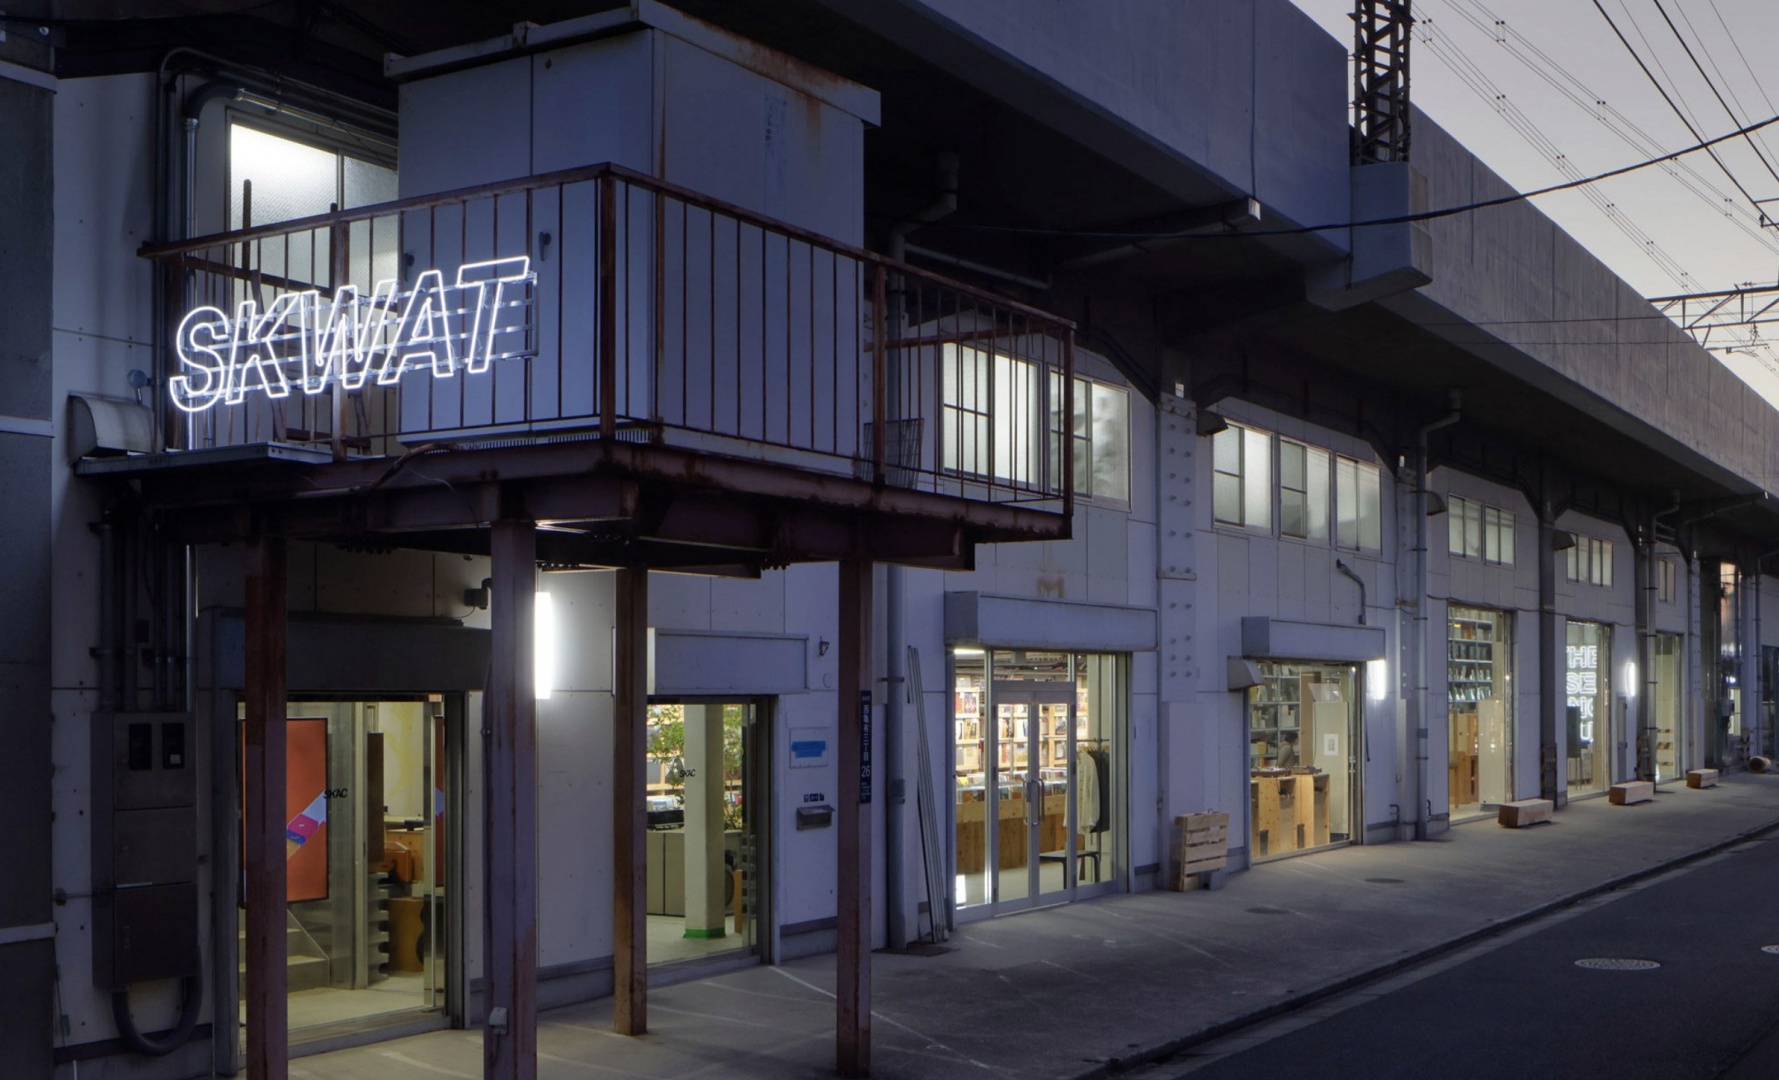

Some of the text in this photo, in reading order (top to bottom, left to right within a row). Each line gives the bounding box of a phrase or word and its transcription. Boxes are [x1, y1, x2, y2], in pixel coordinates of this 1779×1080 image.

[169, 255, 530, 412] SKWAT
[1566, 645, 1597, 668] THE
[680, 769, 696, 778] SKAC
[861, 765, 871, 778] 26
[323, 789, 348, 799] SKAC
